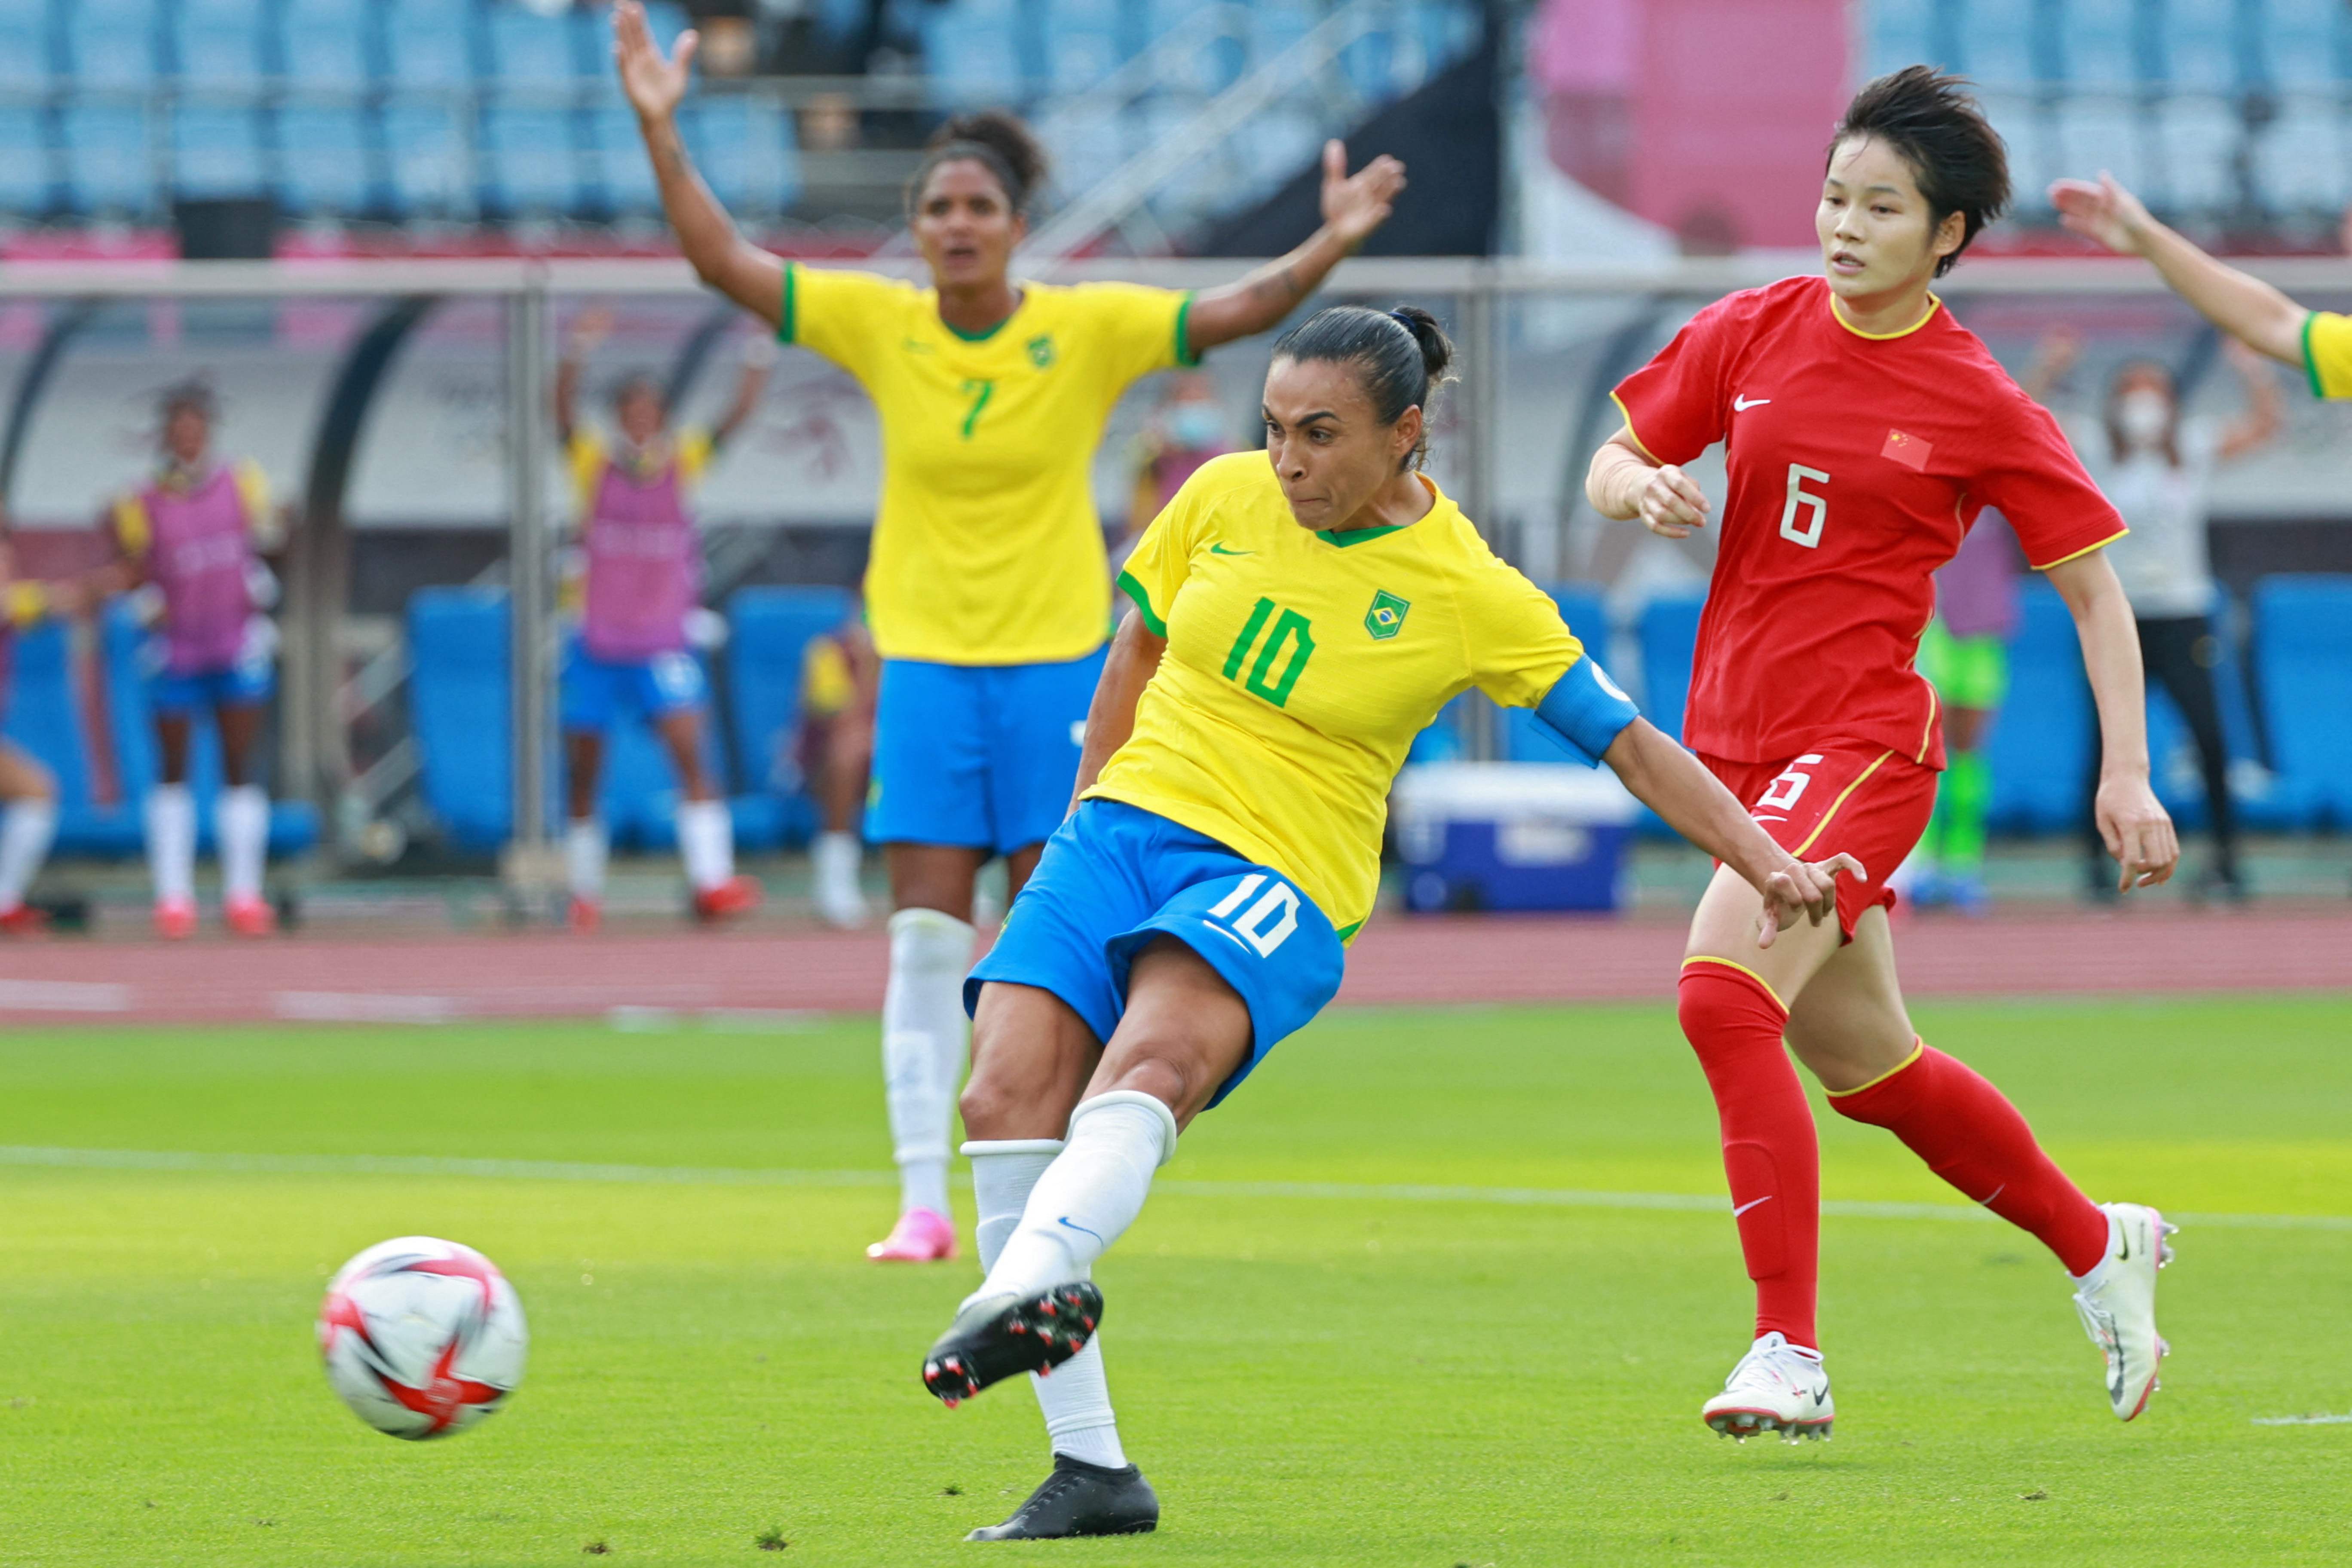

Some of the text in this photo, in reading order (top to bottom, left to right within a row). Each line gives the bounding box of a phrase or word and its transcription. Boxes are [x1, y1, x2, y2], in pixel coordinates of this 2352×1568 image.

[963, 379, 992, 436] 7
[1779, 463, 1830, 548] 6
[1222, 596, 1316, 708] 10
[1207, 873, 1301, 959] 10
